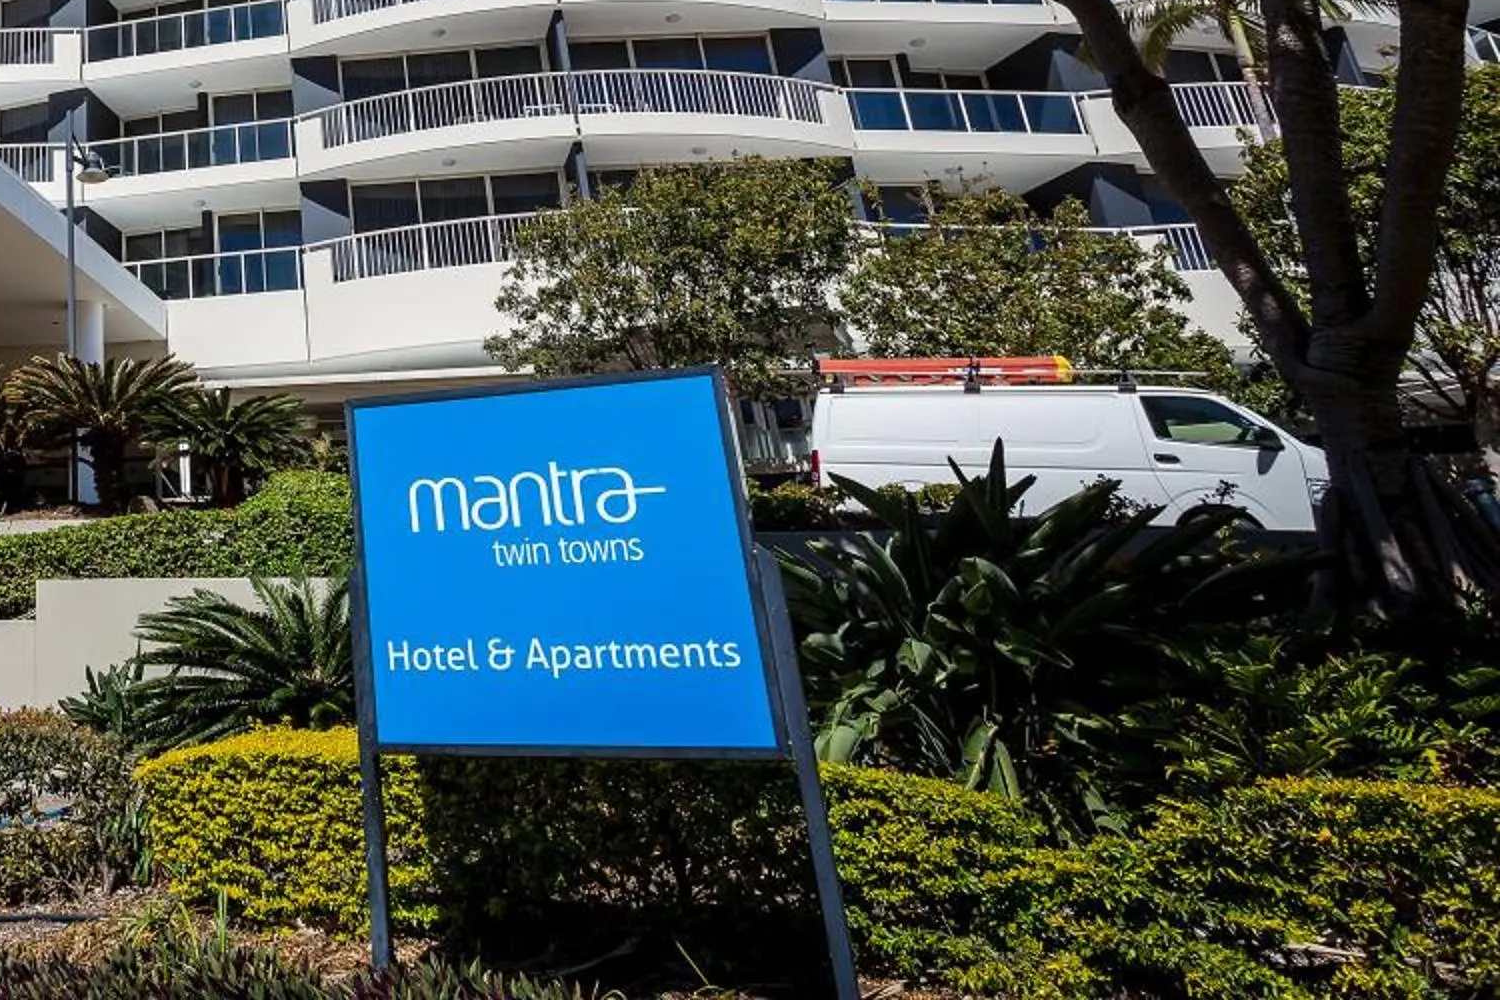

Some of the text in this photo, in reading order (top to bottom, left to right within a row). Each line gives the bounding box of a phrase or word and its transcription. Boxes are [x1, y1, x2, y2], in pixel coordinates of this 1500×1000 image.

[409, 461, 666, 533] mantra
[492, 536, 645, 567] twin towns
[387, 637, 742, 679] Hotel & Apartments
